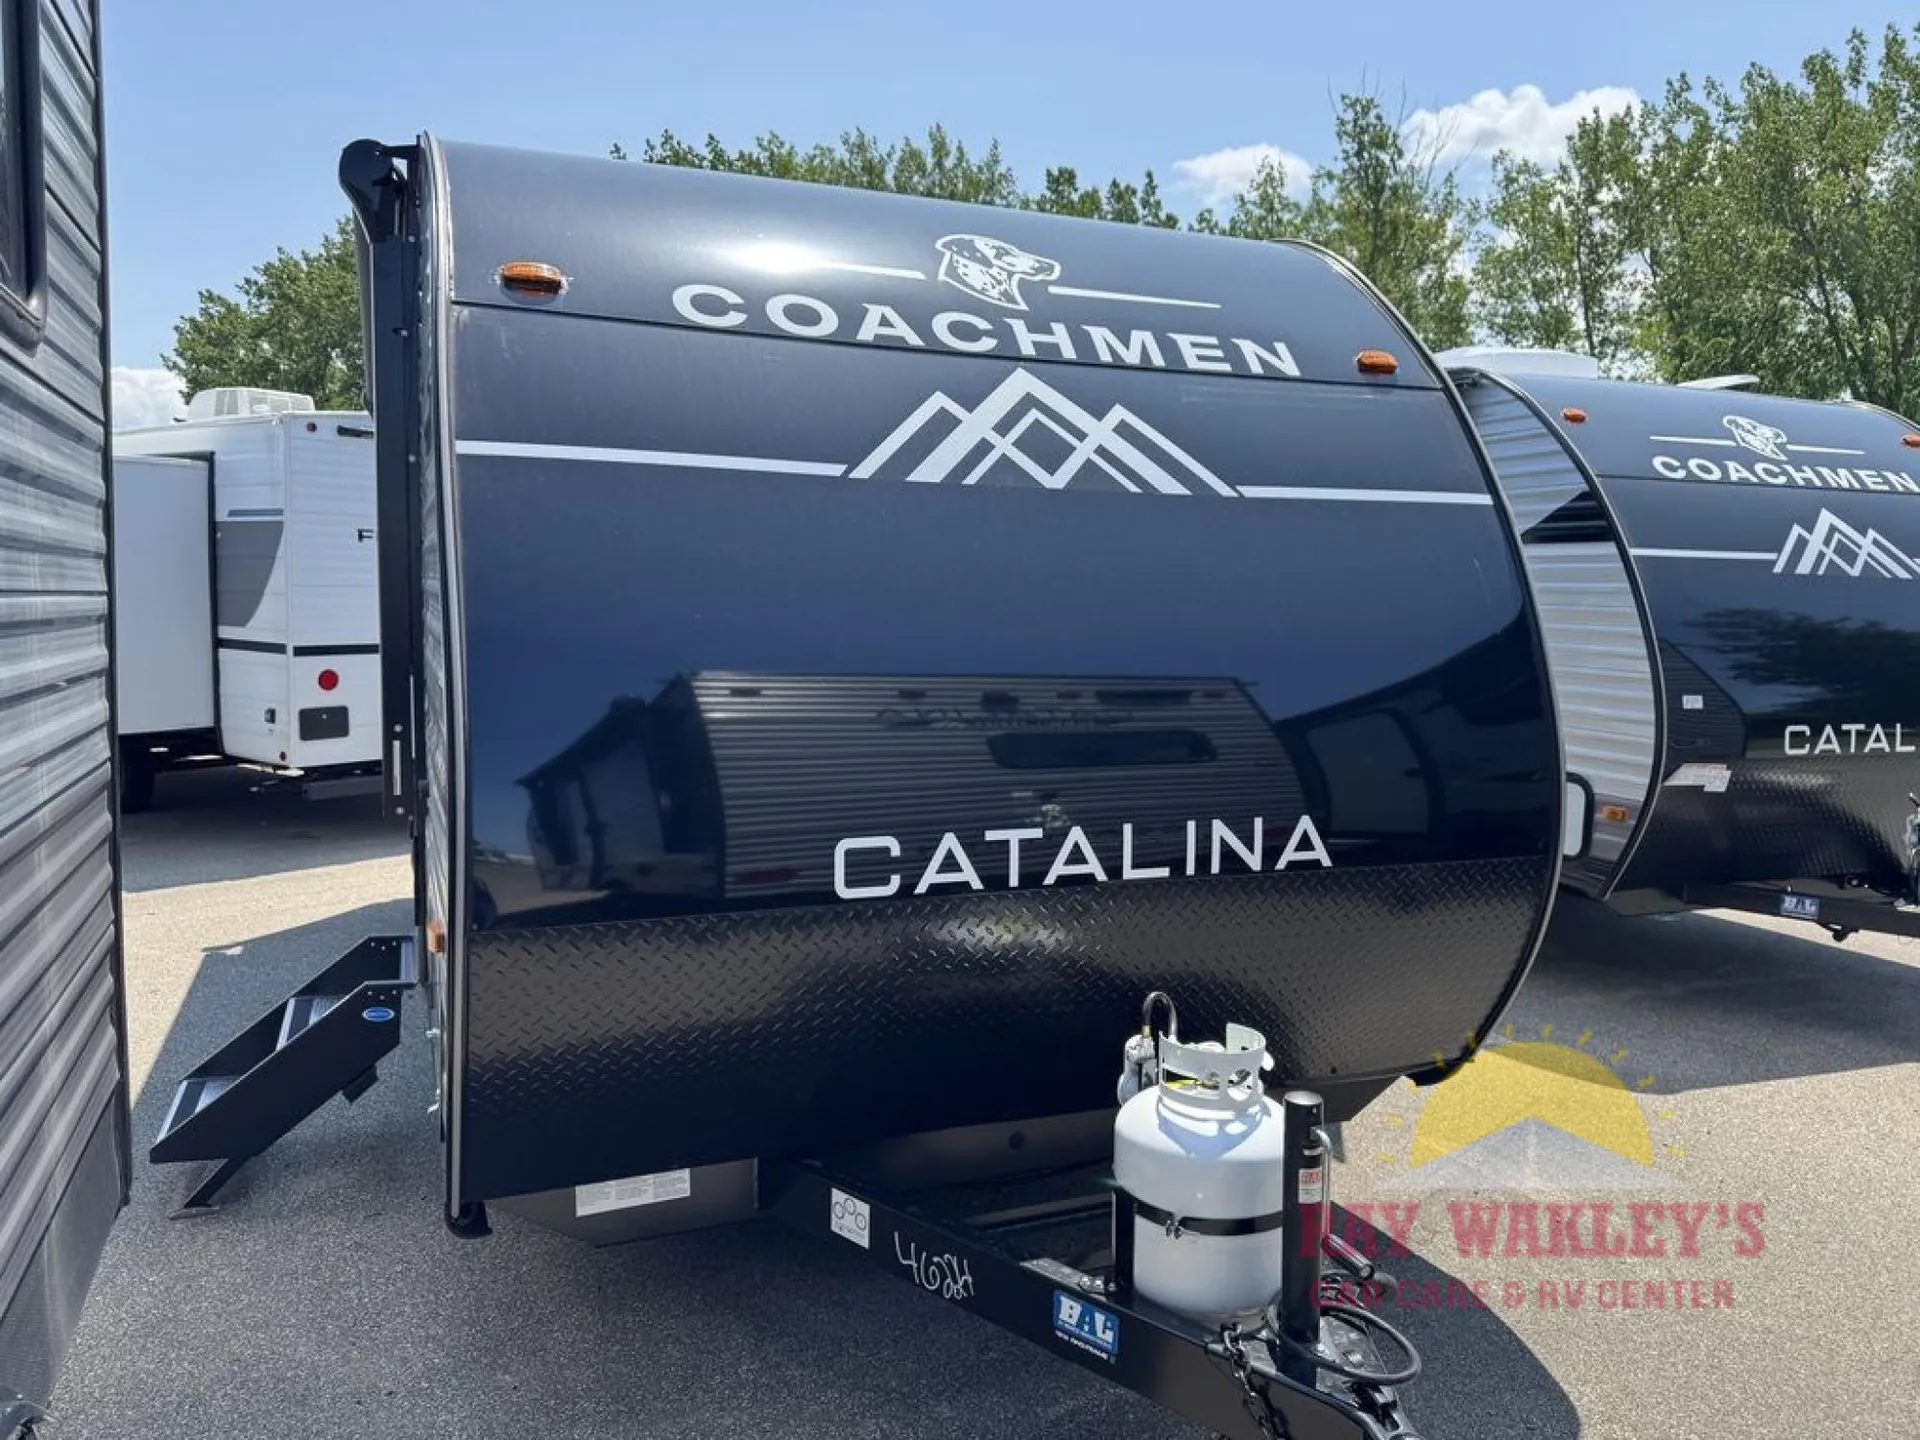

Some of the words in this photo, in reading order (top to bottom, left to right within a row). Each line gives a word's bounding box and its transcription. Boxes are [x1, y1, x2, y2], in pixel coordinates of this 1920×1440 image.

[671, 282, 1302, 378] COACHMEN
[1651, 455, 1920, 493] COACHMEN
[1783, 722, 1917, 756] CATAL
[832, 814, 1334, 900] CATALINA
